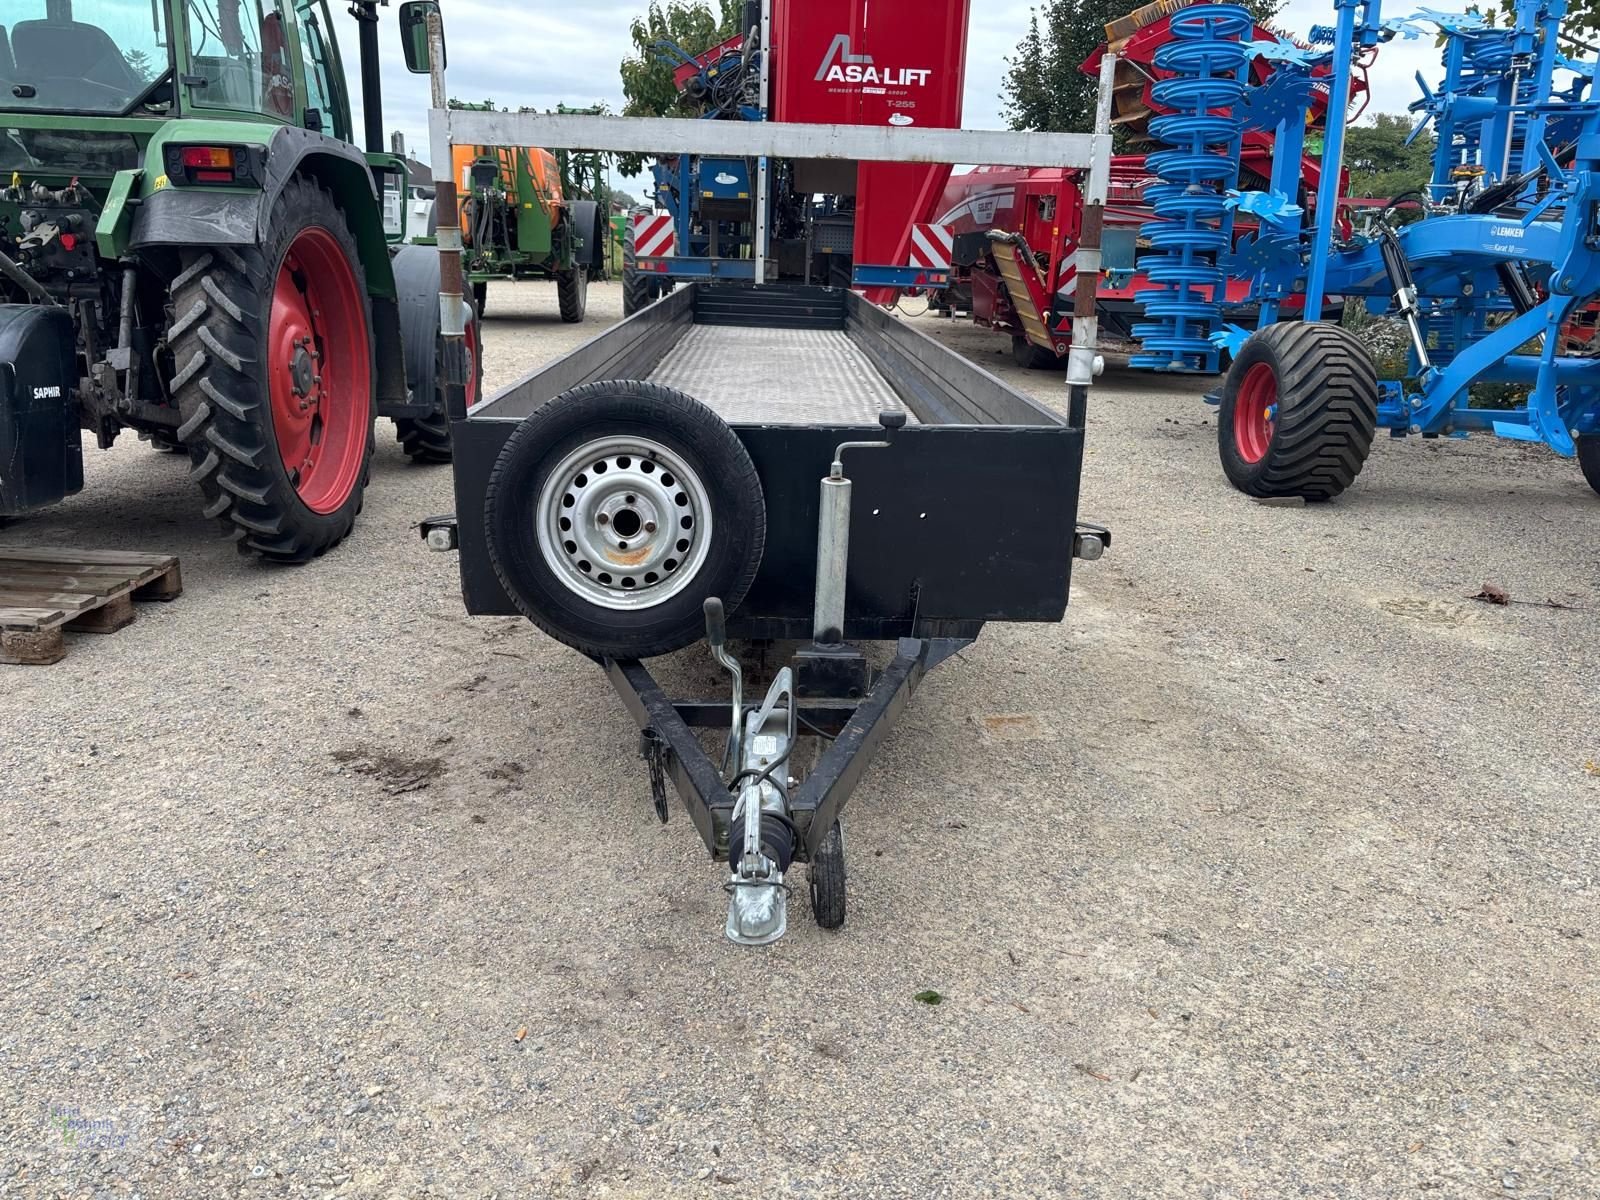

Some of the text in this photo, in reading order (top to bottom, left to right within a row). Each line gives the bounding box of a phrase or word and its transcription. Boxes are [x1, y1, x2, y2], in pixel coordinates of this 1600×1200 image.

[886, 100, 916, 109] T-255
[1497, 227, 1524, 238] LEMKEN
[33, 386, 61, 399] SAPHIR
